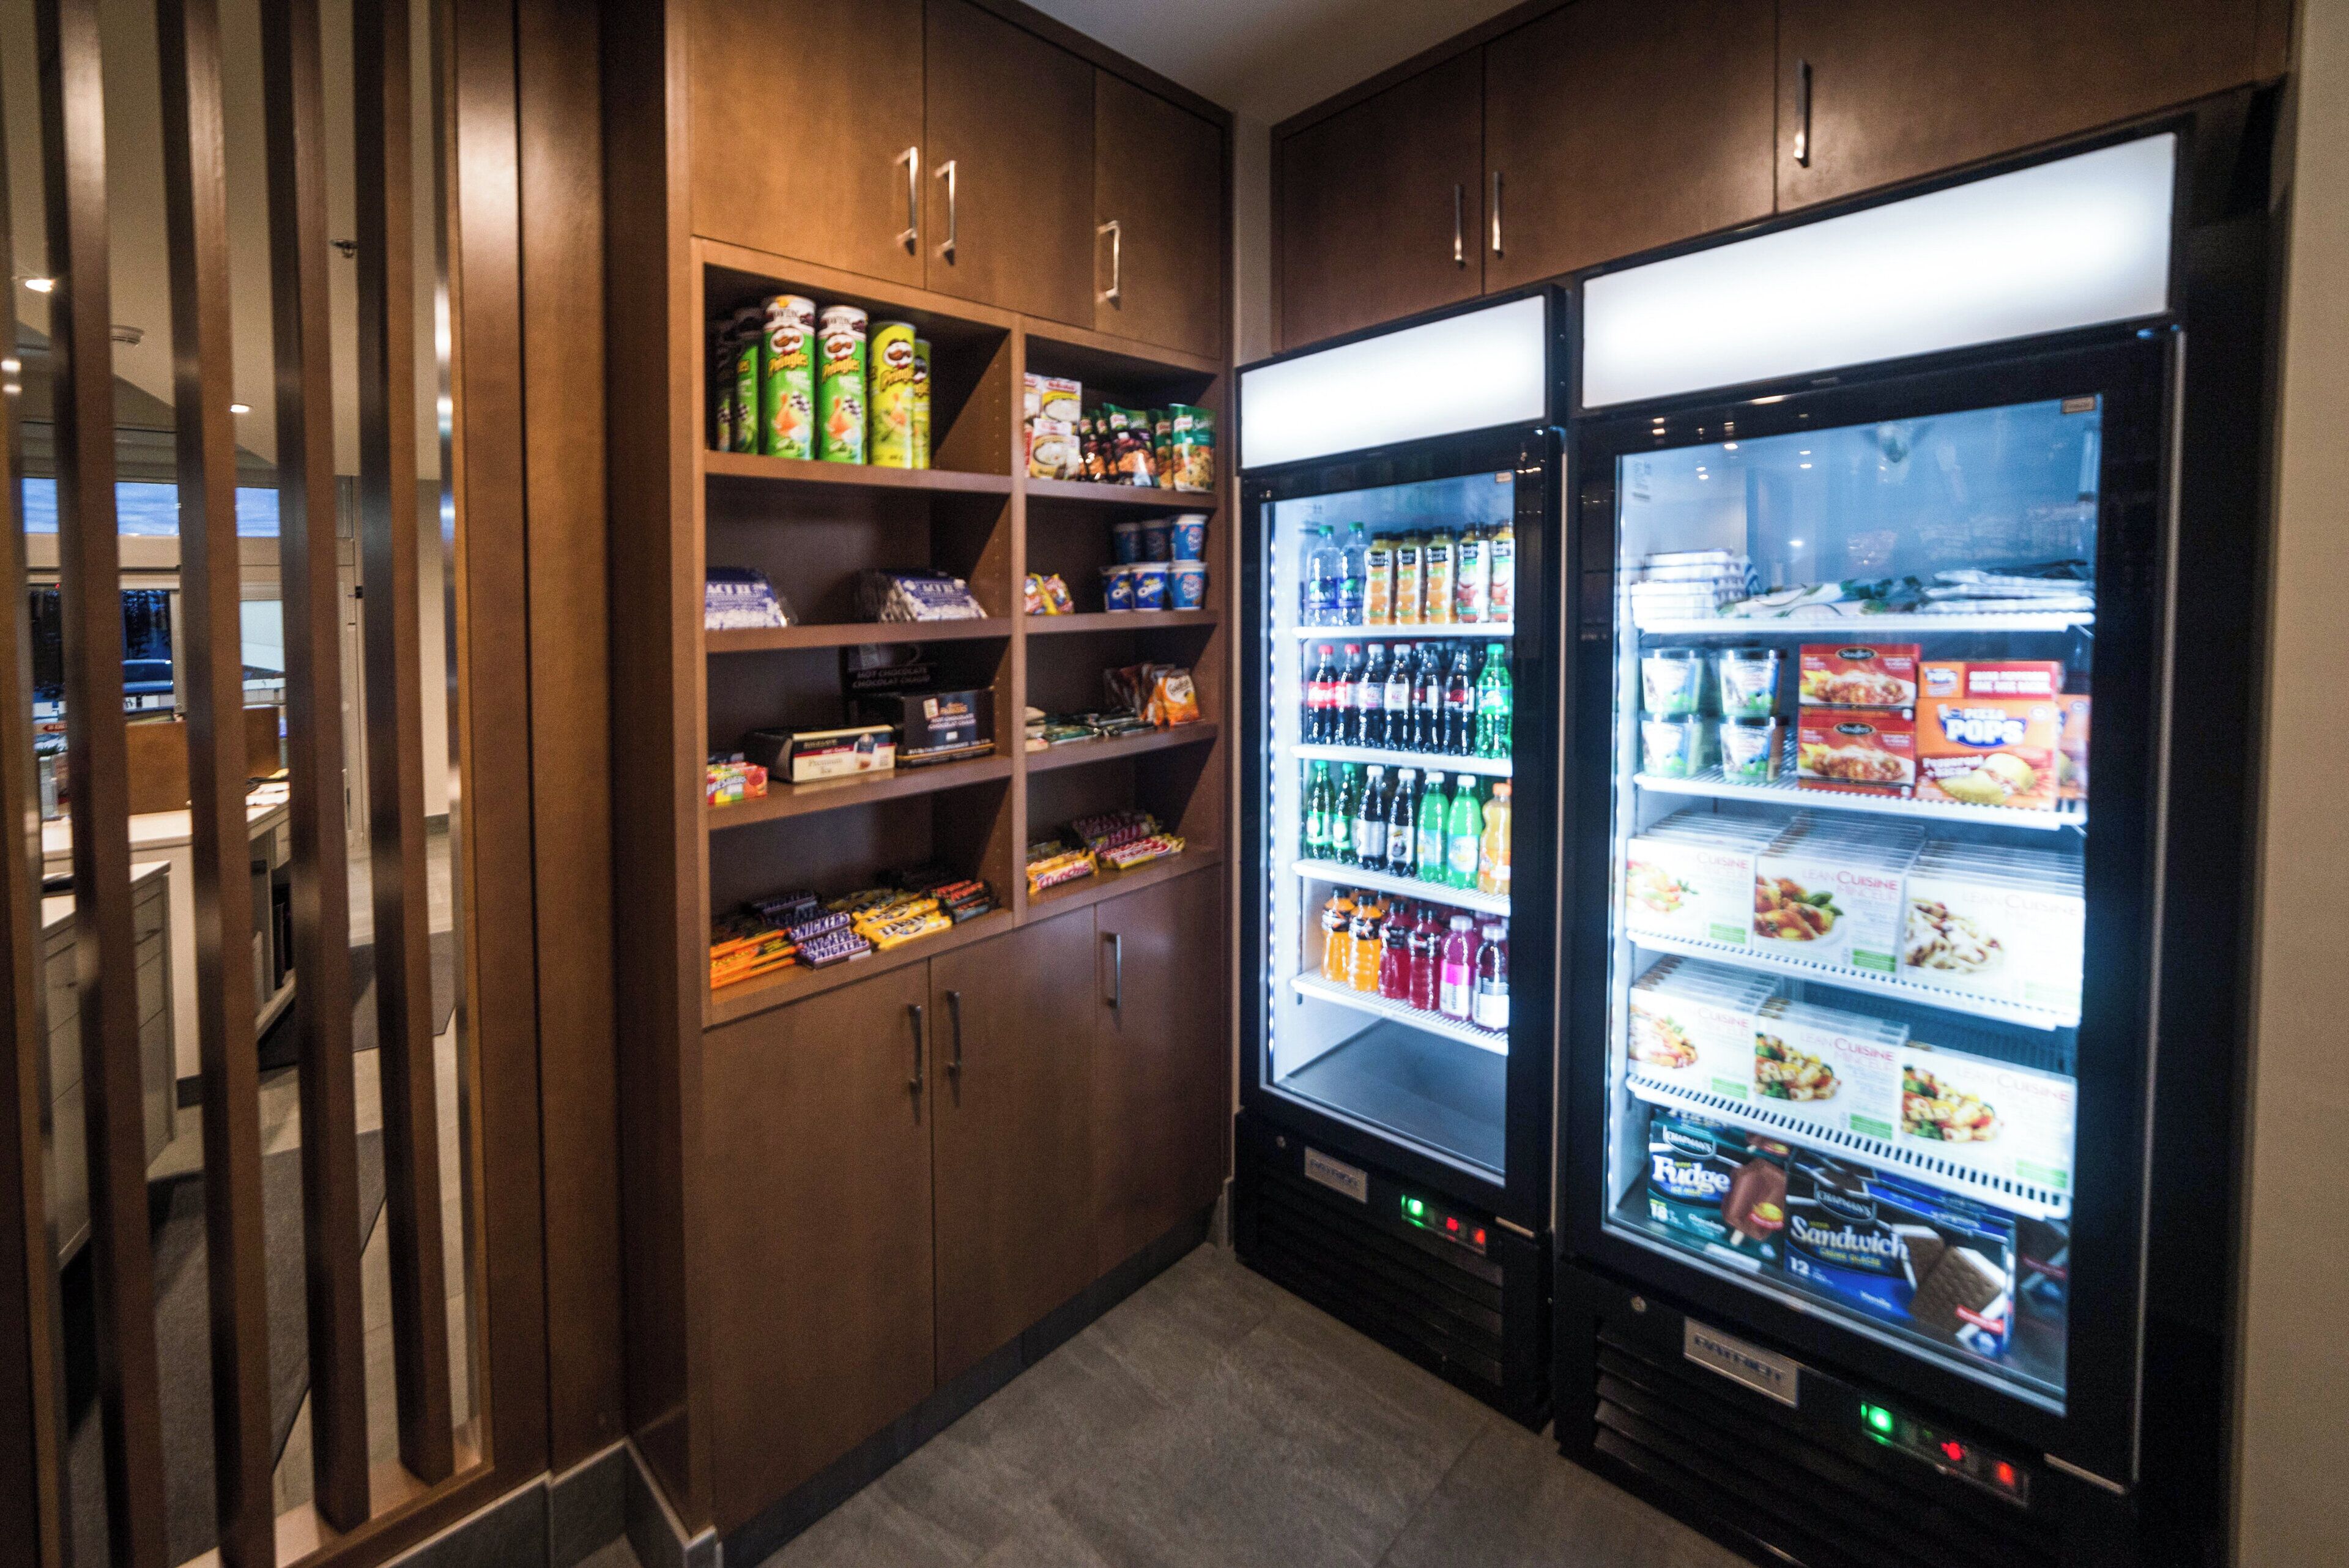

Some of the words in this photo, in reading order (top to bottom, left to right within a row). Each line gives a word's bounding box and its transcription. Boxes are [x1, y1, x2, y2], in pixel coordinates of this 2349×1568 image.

[1946, 719, 2024, 745] POPS
[1696, 852, 1749, 869] CUISINE
[1803, 869, 1835, 881] LEAN
[1836, 870, 1899, 891] CUISINE
[2005, 894, 2077, 916] CUISINE
[790, 913, 848, 940] SNICKERS
[809, 940, 869, 961] SNICKERS
[1697, 1006, 1749, 1028] CUISINE
[1834, 1036, 1896, 1061] CUISINE
[1995, 1072, 2070, 1102] CUISINE
[1652, 1154, 1730, 1194] Fudge
[1650, 1202, 1669, 1222] 18
[1791, 1214, 1909, 1261] Sandwich
[1790, 1255, 1810, 1277] 12
